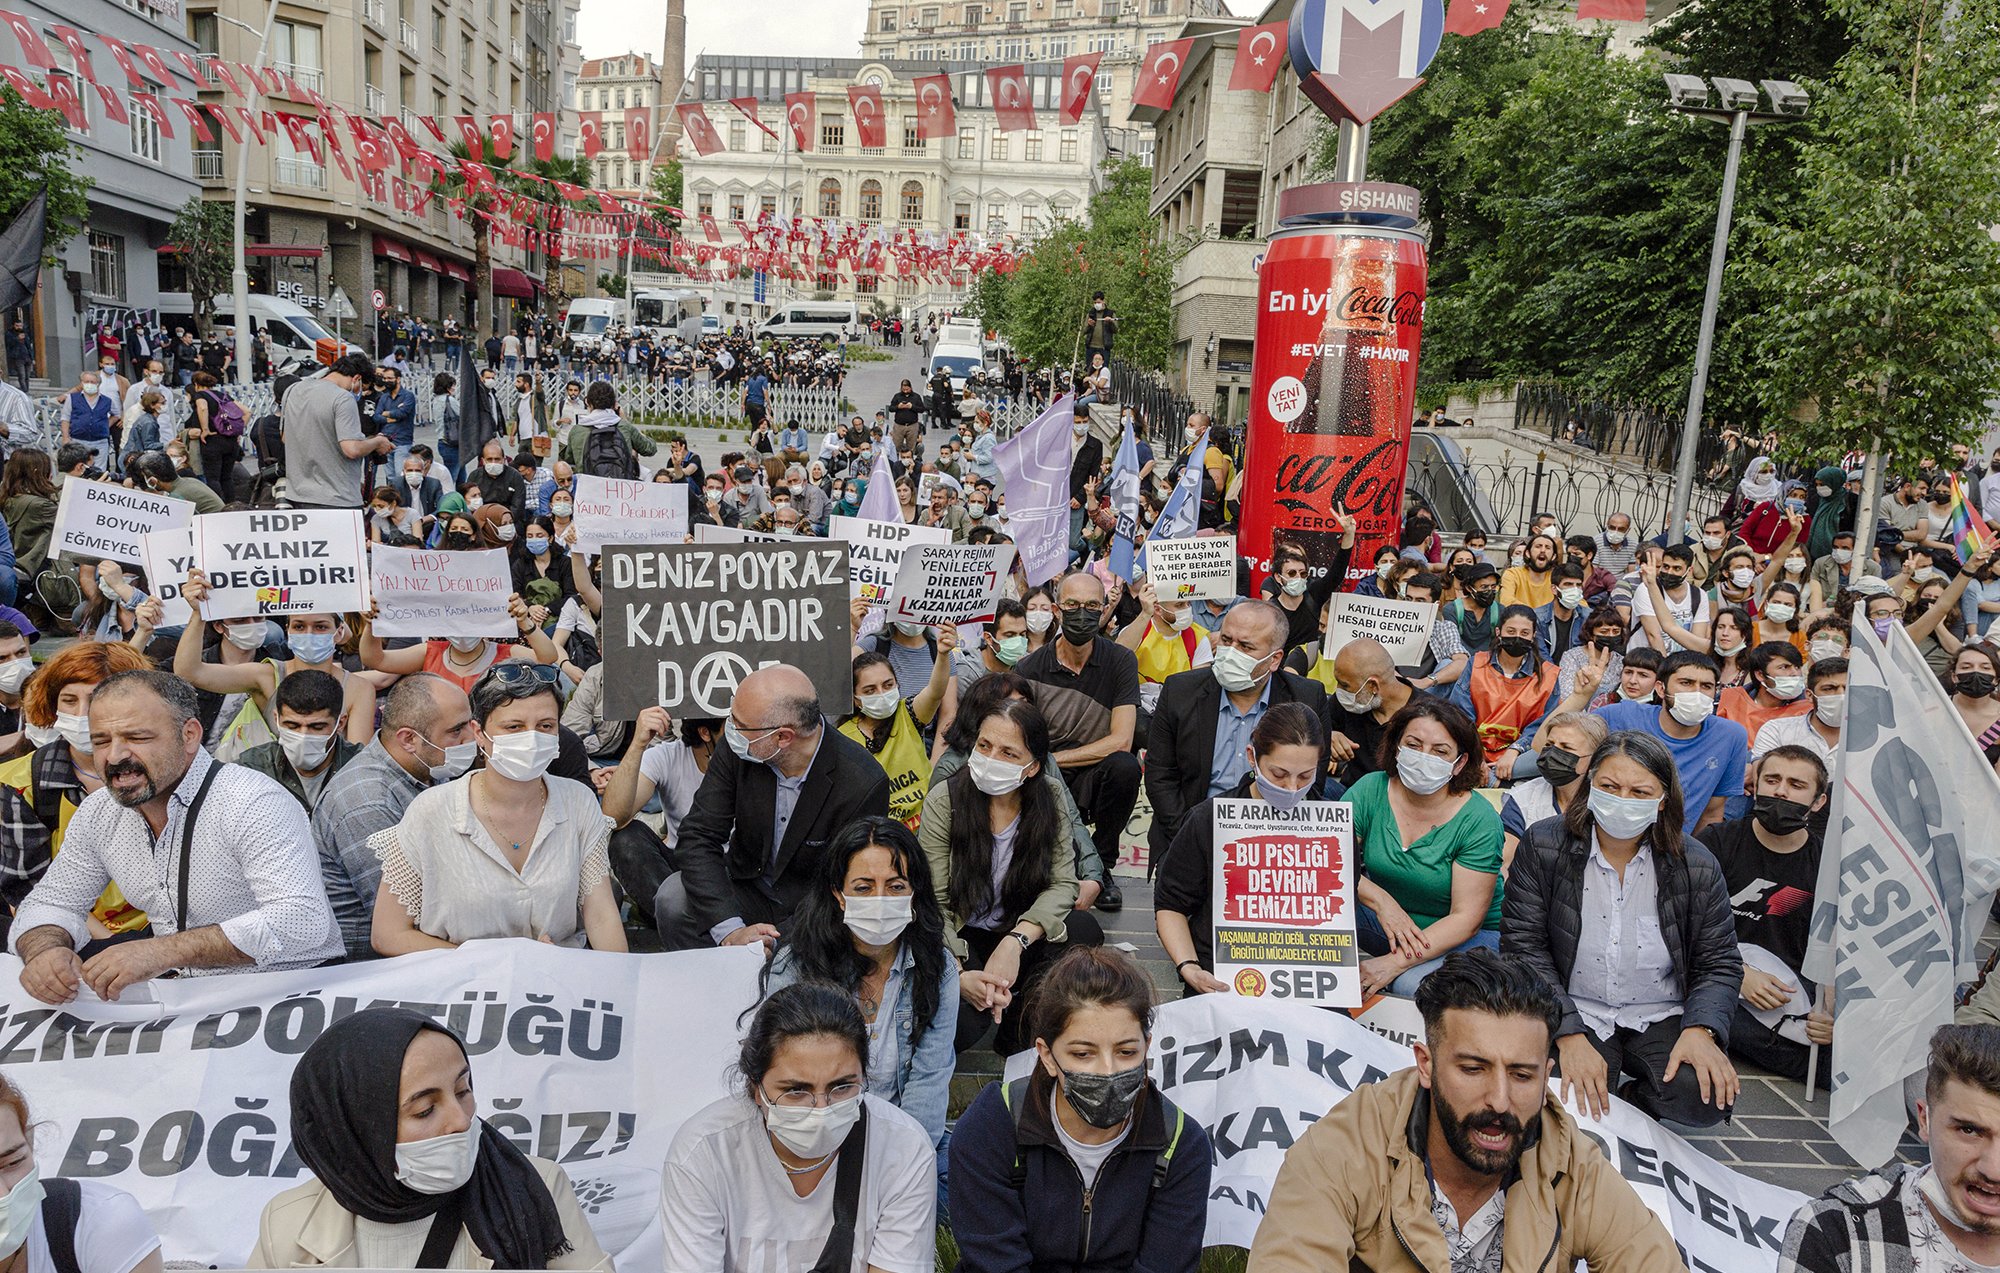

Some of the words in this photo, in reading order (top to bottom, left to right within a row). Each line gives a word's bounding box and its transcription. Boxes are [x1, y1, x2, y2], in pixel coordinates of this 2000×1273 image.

[1339, 187, 1414, 213] ŞİŞHANE
[276, 281, 303, 294] BIG
[1269, 290, 1295, 312] En
[1302, 288, 1332, 315] iyi
[1291, 344, 1347, 357] #EVET
[1359, 346, 1409, 362] #HAYIR
[1272, 384, 1300, 402] YENİ
[1276, 399, 1298, 413] TAT
[606, 480, 644, 501] HDP
[86, 488, 170, 517] BASKILARA
[96, 514, 152, 534] BOYUN
[249, 514, 308, 533] HDP
[867, 523, 911, 541] HDP
[1292, 515, 1336, 529] ZERO
[1356, 519, 1388, 531] UGAR
[64, 531, 141, 558] EĞMEYEC
[223, 540, 329, 561] YALNIZ
[922, 547, 961, 559] SARAY
[963, 546, 996, 560] REJİMİ
[1152, 542, 1207, 552] KURTULUŞ
[1209, 540, 1230, 549] YOK
[411, 553, 450, 571] HDP
[849, 544, 905, 564] YALN
[1161, 553, 1181, 561] TEK
[1184, 551, 1221, 560] BAŞINA
[719, 550, 844, 592] POYRAZ
[921, 559, 993, 573] YENİLECEK
[1152, 564, 1165, 572] YA
[1168, 562, 1186, 571] HEP
[1189, 560, 1232, 570] BERABER
[1155, 573, 1168, 581] YA
[1171, 571, 1188, 581] HİÇ
[1191, 569, 1231, 579] BİRİMİZ!
[210, 563, 355, 589] DEĞİLDİR!
[375, 571, 431, 591] YALNIZ
[928, 573, 985, 587] DİRENEN
[924, 588, 982, 600] HALKLAR
[908, 599, 990, 612] KAZANACAK!
[1347, 603, 1420, 620] KATİLLERDEN
[626, 598, 824, 647] KAVGADIR
[1337, 614, 1376, 629] HESABI
[1379, 621, 1425, 634] GENÇLİK
[1217, 804, 1236, 819] NE
[1241, 805, 1311, 822] ARARSAN
[1315, 807, 1349, 823] VAR!
[1219, 822, 1243, 830] Tecavüz,
[1244, 823, 1266, 831] Cinayet,
[1236, 843, 1260, 867] BU
[1248, 869, 1317, 893] DEVRİM
[1235, 895, 1332, 920] TEMİZLER!
[1218, 931, 1268, 945] YAŞANANLAR
[1269, 930, 1284, 944] DİZİ
[1286, 931, 1308, 946] DEĞİL,
[1309, 935, 1352, 947] SEYRETME!
[1230, 946, 1264, 959] ÖRGÜTLÜ
[1266, 946, 1316, 961] MÜCADELEYE
[1317, 949, 1341, 962] KATIL!
[1270, 969, 1338, 999] SEP
[1149, 1028, 1289, 1091] İZM
